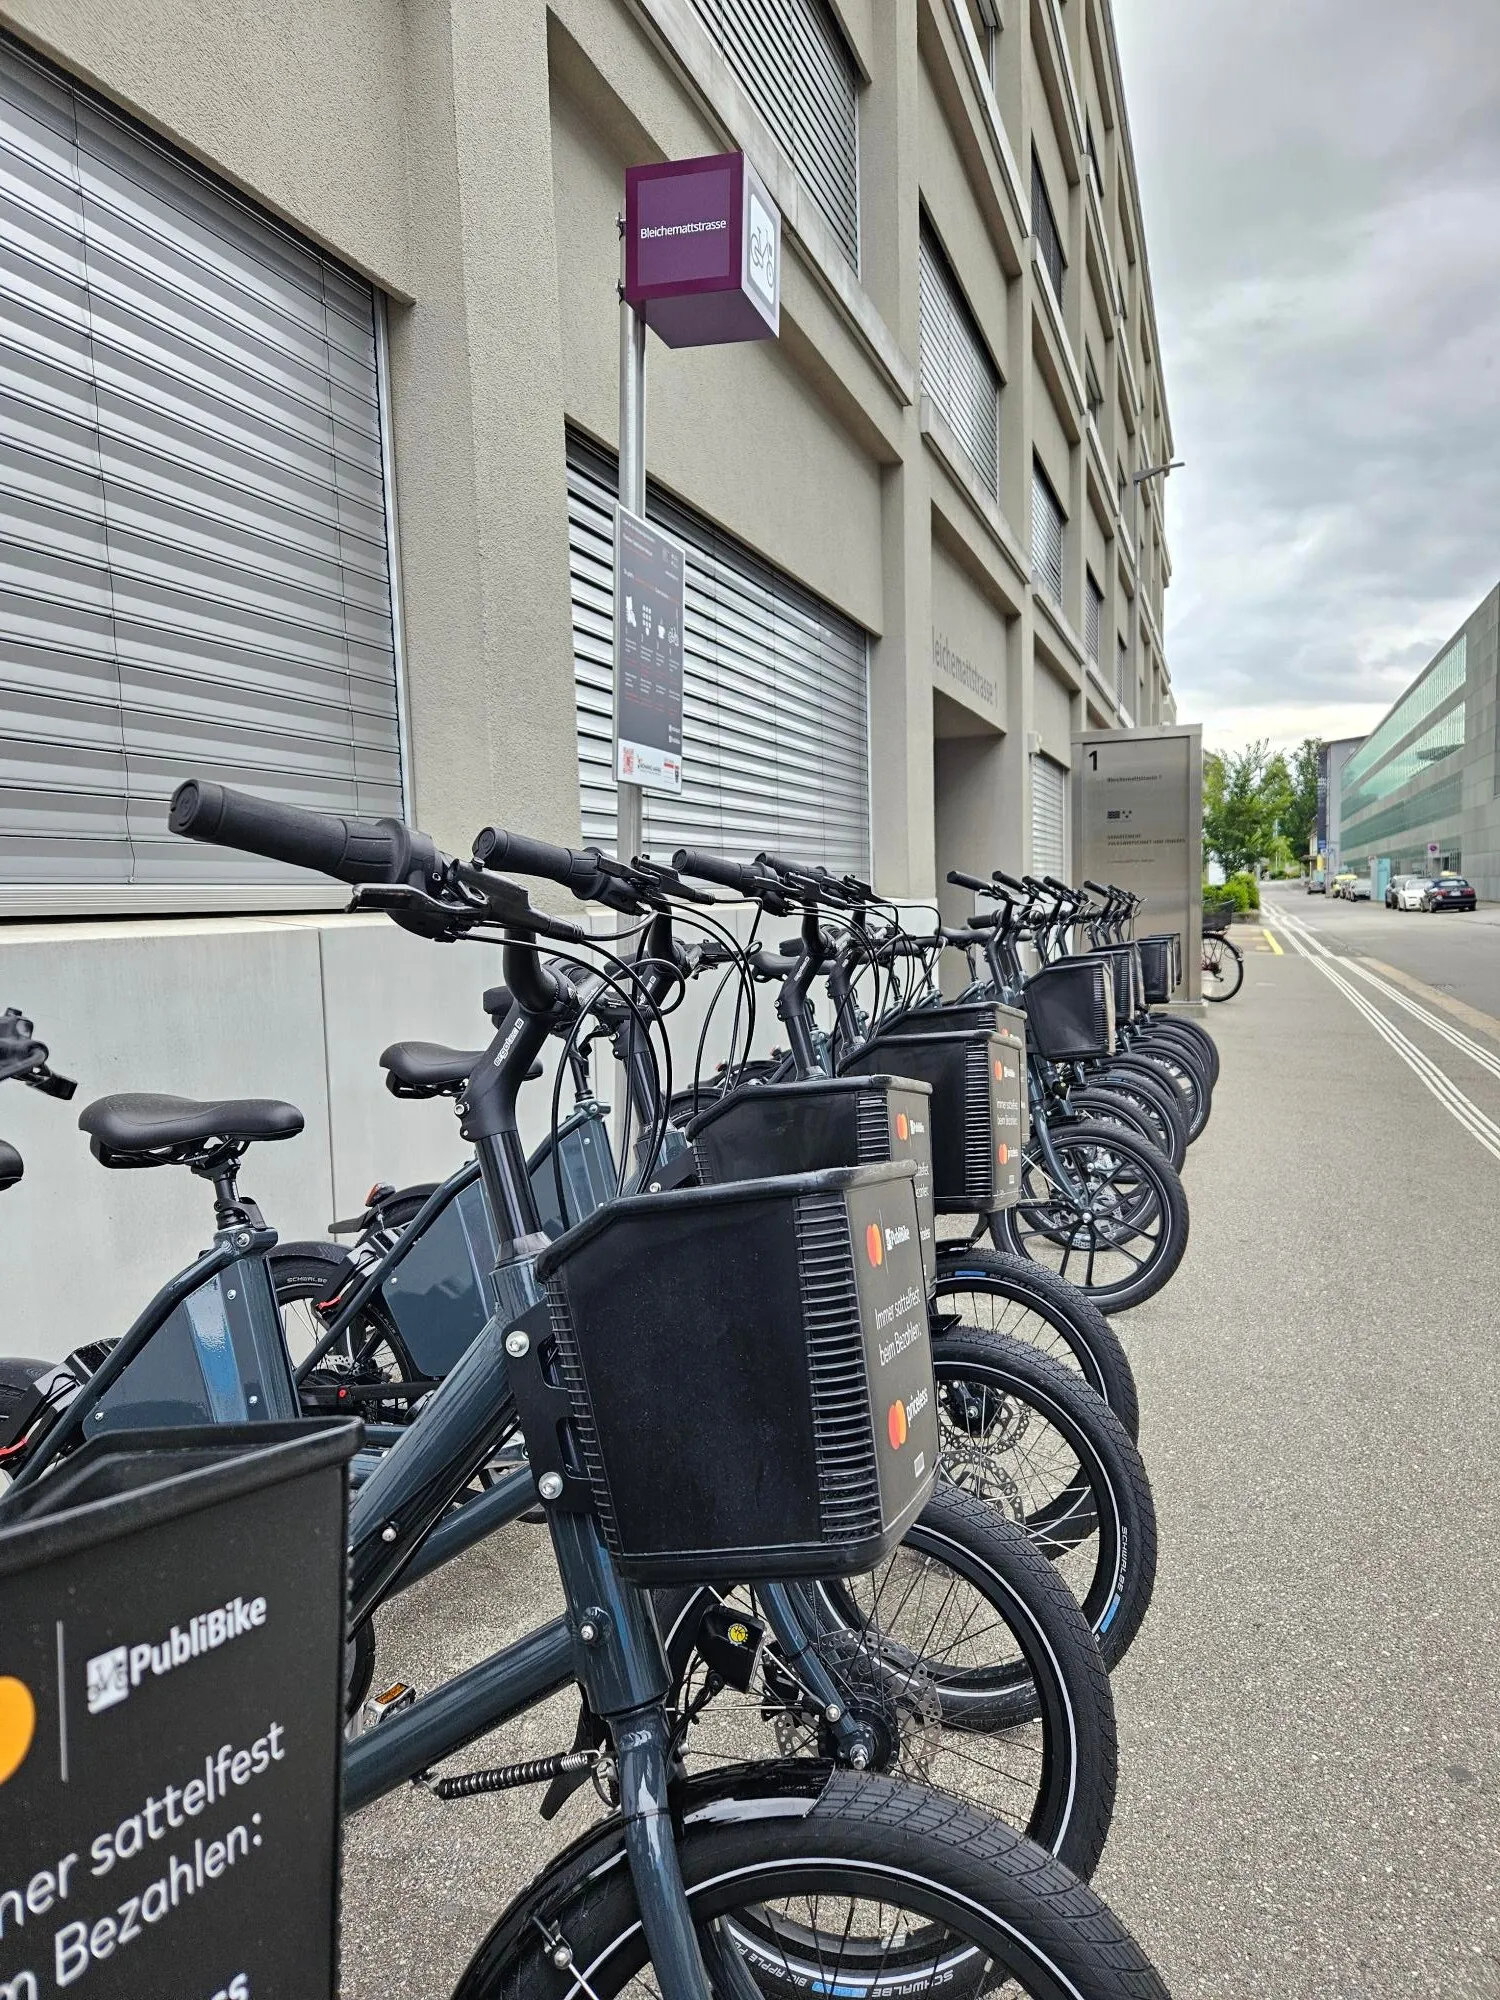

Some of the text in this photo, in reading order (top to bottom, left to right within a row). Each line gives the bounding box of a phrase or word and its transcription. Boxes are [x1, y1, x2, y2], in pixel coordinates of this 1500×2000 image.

[640, 219, 727, 239] Bleichemattstrasse
[931, 624, 993, 706] leichemattstrasse
[1088, 750, 1098, 772] 1
[874, 1304, 895, 1330] Immer
[878, 1340, 896, 1367] beim
[1117, 1525, 1128, 1593] SCHWALBE
[130, 1596, 267, 1687] PubliBike
[90, 1721, 286, 1876] sattelfest
[54, 1812, 262, 1988] Bezahlen:
[748, 1953, 785, 1977] APPLE
[871, 1969, 954, 1999] SCHWALBE
